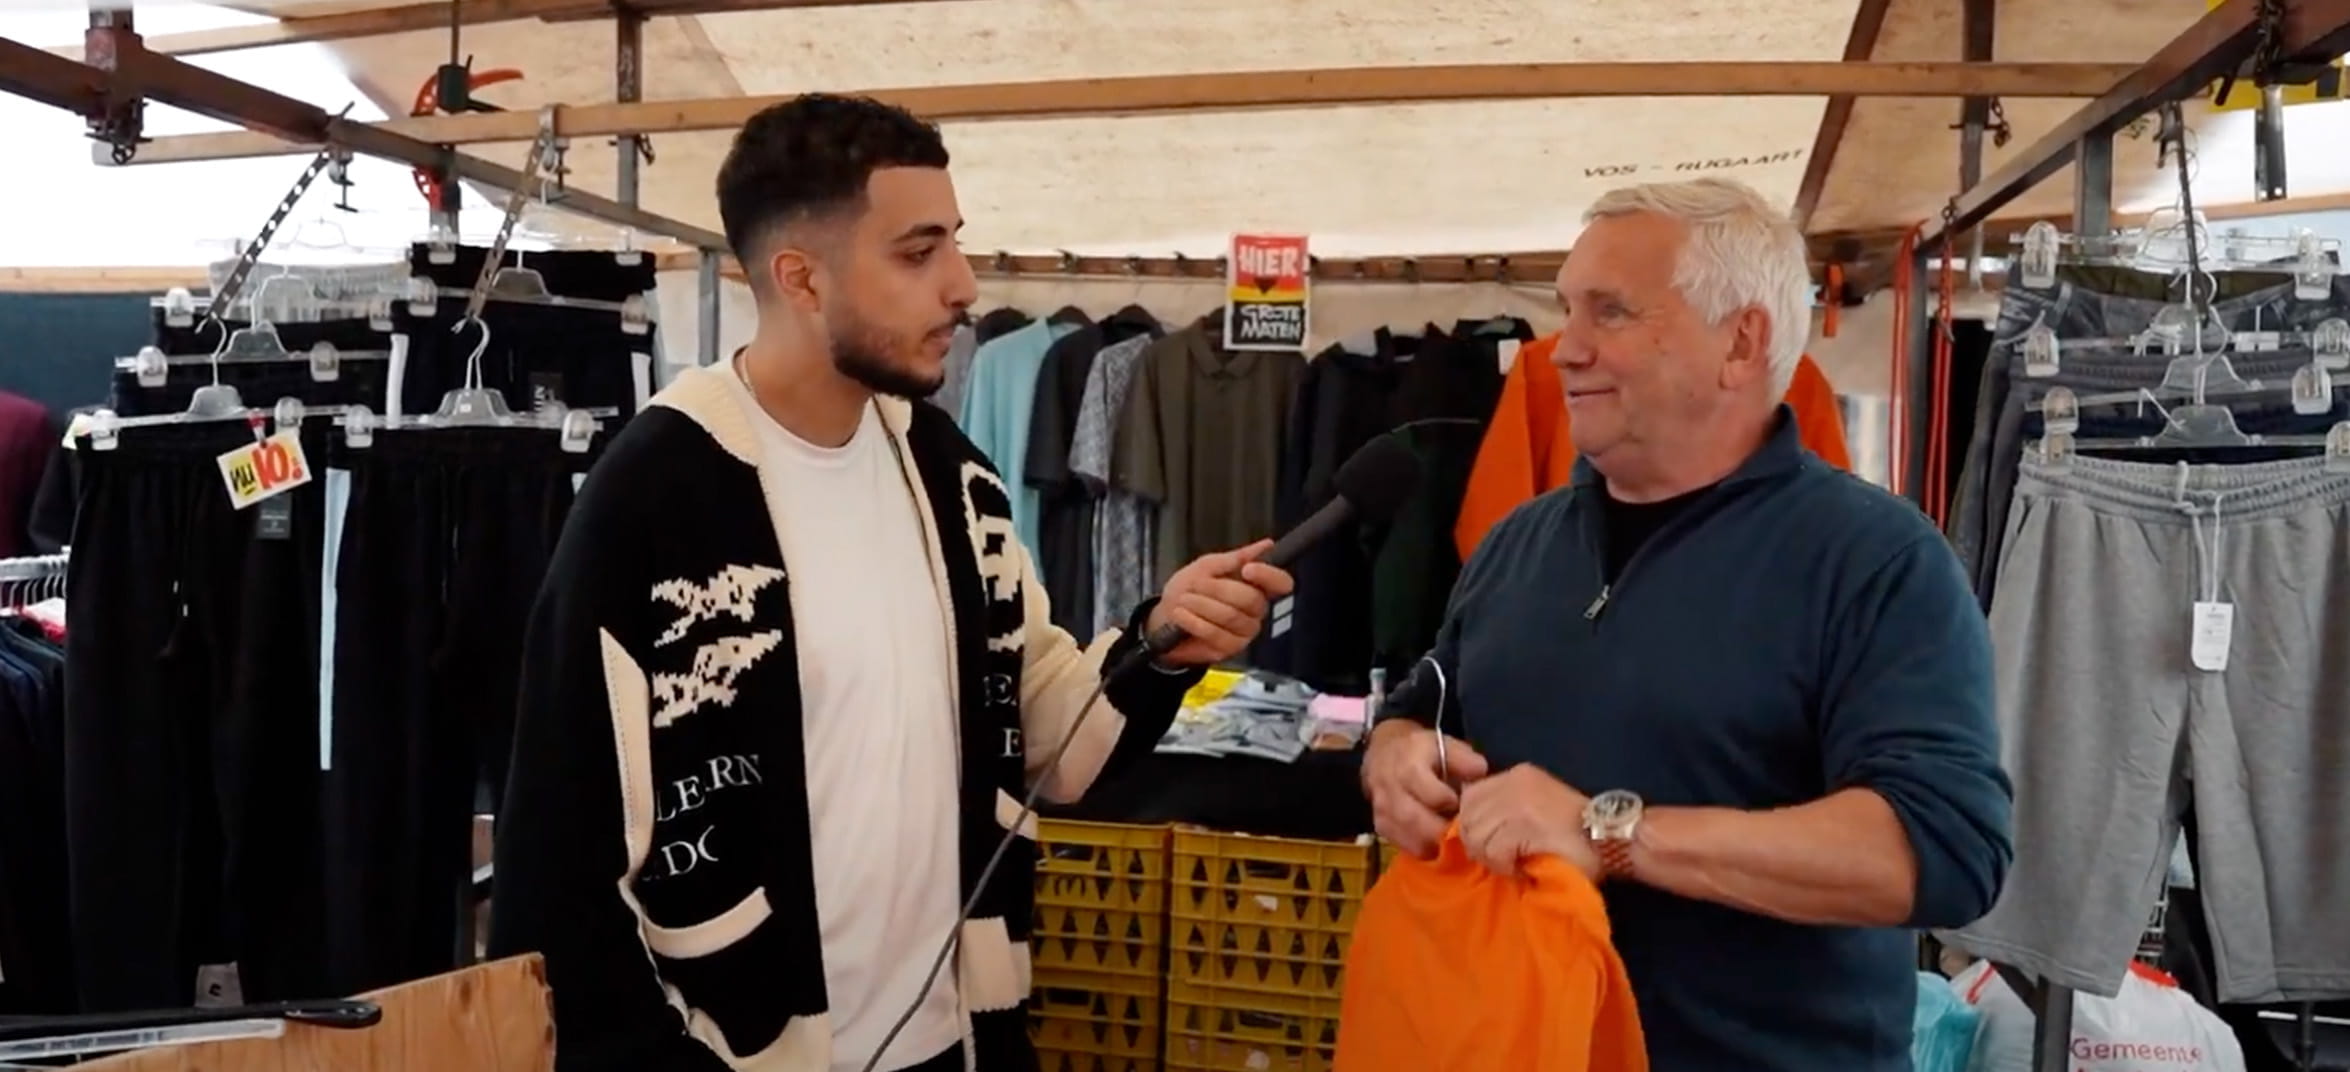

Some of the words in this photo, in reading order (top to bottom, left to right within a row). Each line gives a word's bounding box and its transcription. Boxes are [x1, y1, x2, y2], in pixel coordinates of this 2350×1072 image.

[1584, 164, 1638, 178] VOS
[1239, 244, 1300, 277] HIER
[1241, 320, 1300, 339] MATEN
